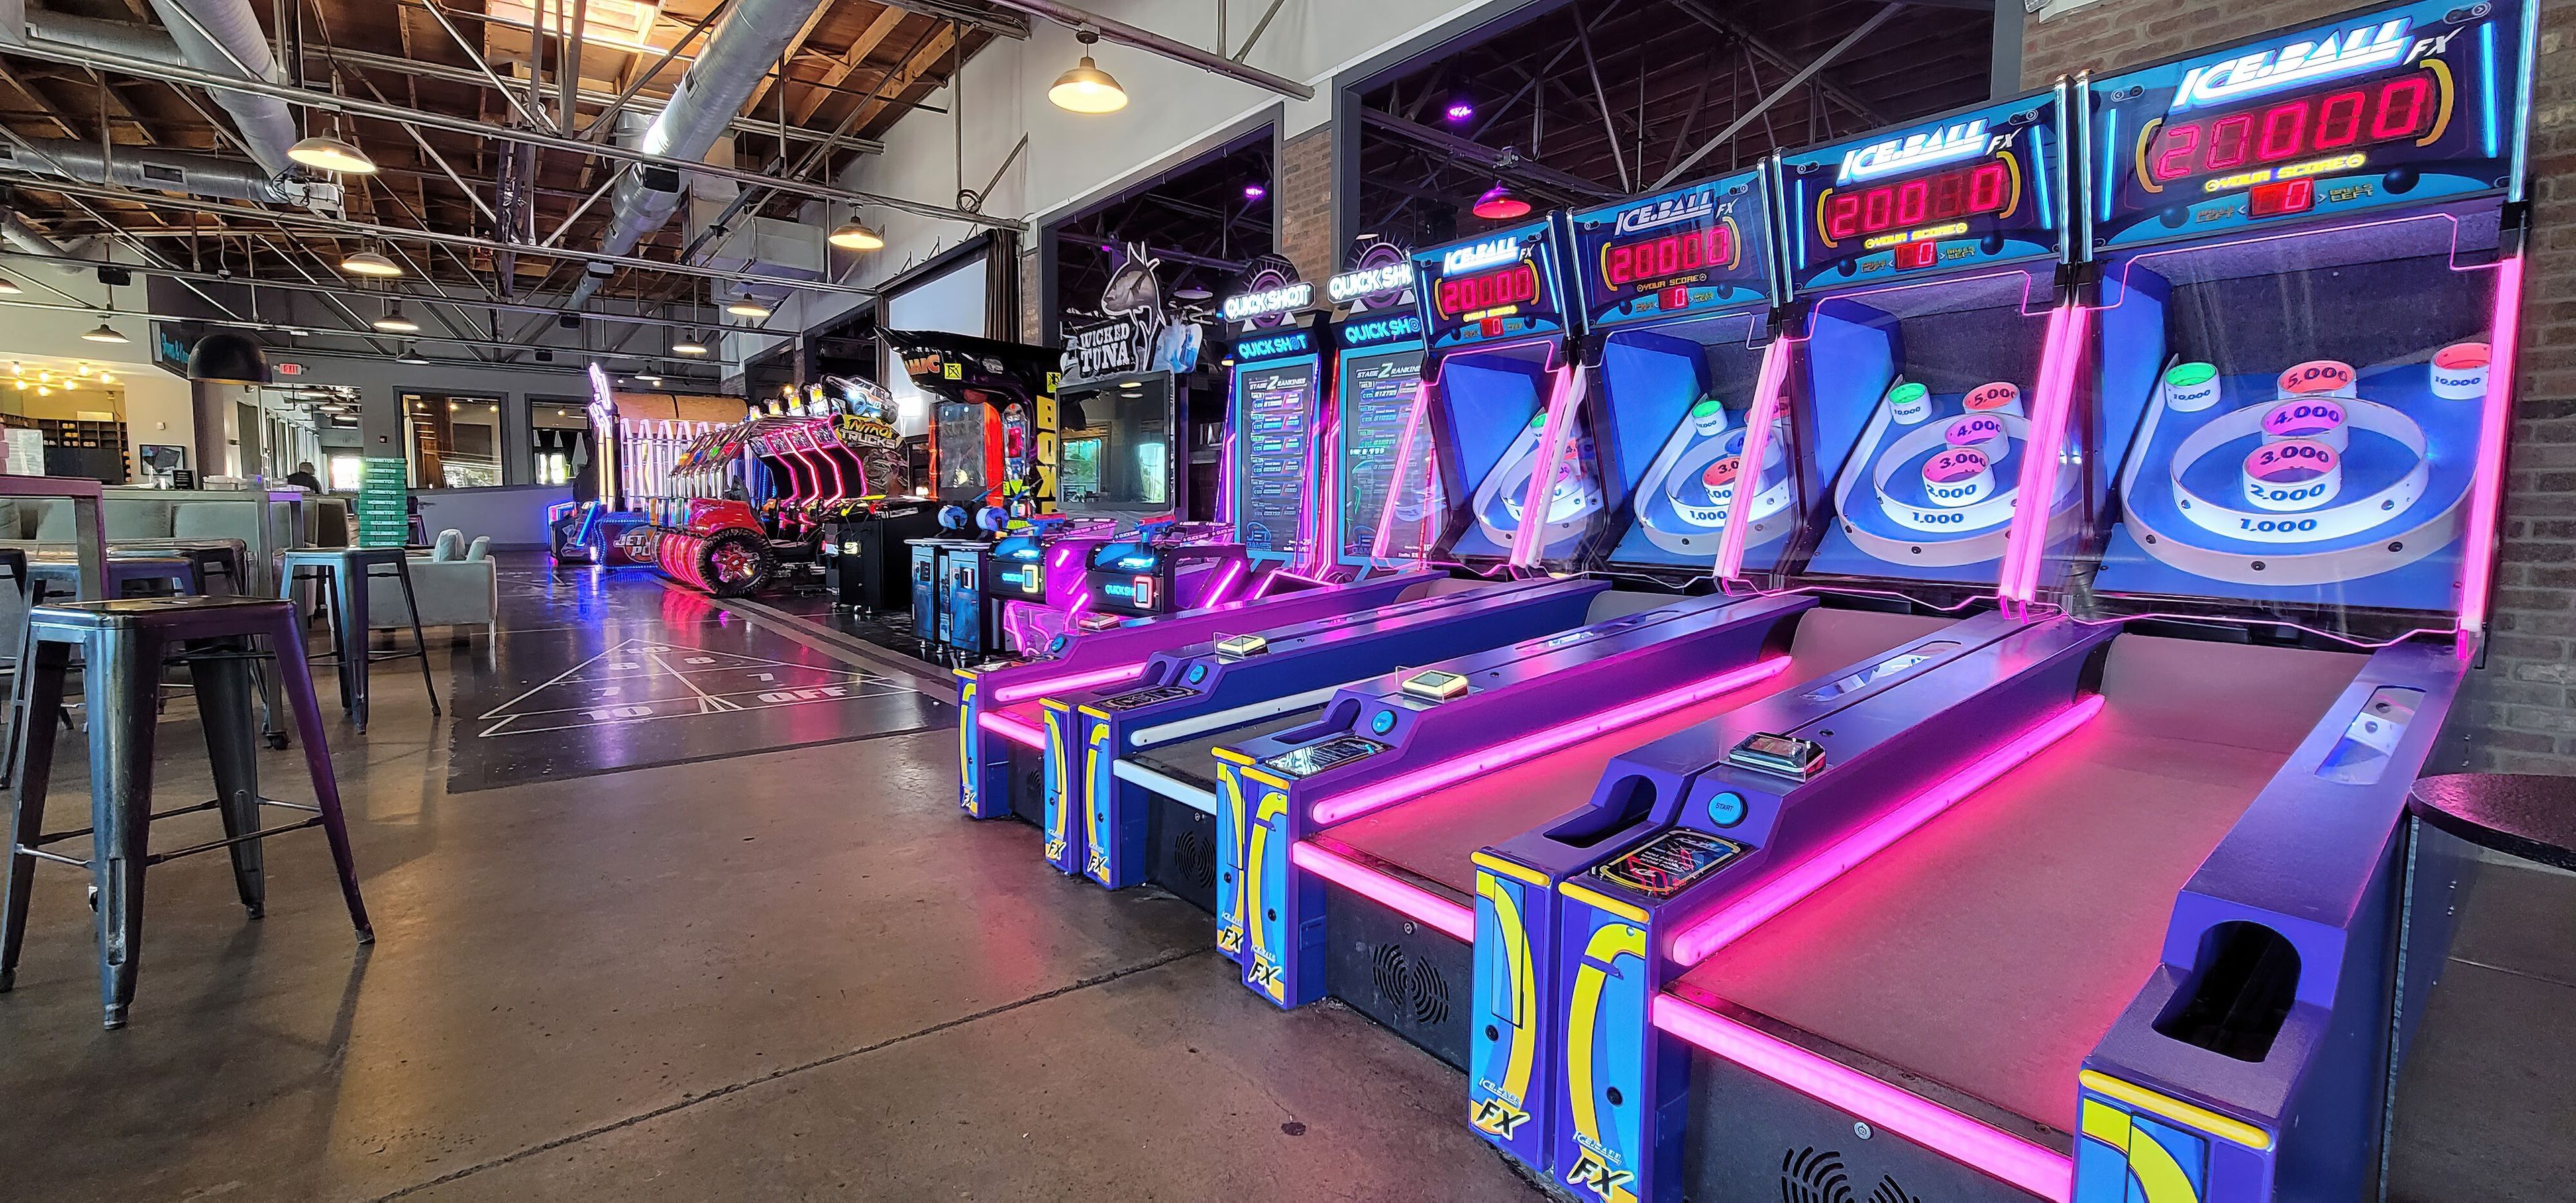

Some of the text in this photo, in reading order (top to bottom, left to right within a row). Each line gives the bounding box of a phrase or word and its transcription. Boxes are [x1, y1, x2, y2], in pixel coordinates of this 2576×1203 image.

[2404, 25, 2466, 66] FX
[2155, 77, 2430, 181] 20000
[1986, 126, 2023, 156] FX
[2218, 156, 2349, 189] YOUR SCORE
[2284, 179, 2311, 209] 0
[1715, 197, 1739, 219] FX
[1519, 244, 1535, 262] FX
[1613, 225, 1730, 283] 20000
[1918, 242, 1934, 265] 0
[1329, 270, 1383, 300] QUICK
[1444, 266, 1533, 313] 20000
[1643, 275, 1699, 291] YOUR SCORE
[1224, 284, 1311, 319] QUICK SHOT
[1674, 287, 1687, 307] 0
[1079, 323, 1130, 349] WICKED
[1345, 317, 1421, 344] QUICK SHO
[1492, 317, 1501, 334] 0
[1080, 340, 1130, 373] TUNA
[1238, 334, 1307, 359] QUICK SHOT
[1356, 370, 1379, 378] STAGE
[2288, 367, 2348, 388] 5,000
[2275, 405, 2340, 426] 4,000
[839, 428, 896, 450] TRUCKS
[849, 419, 890, 438] NITRO
[2259, 446, 2330, 466] 3,000
[2249, 483, 2327, 502] 2,000
[1246, 530, 1271, 541] JET
[2239, 518, 2318, 533] 1,000
[756, 686, 849, 702] OFF
[578, 705, 654, 721] 10
[1715, 802, 1734, 813] START
[1046, 840, 1067, 861] FX
[1087, 854, 1109, 875] FX
[1220, 926, 1243, 954] FX
[1248, 961, 1283, 989] FX
[1475, 1098, 1530, 1140] FX
[1567, 1155, 1634, 1200] FX
